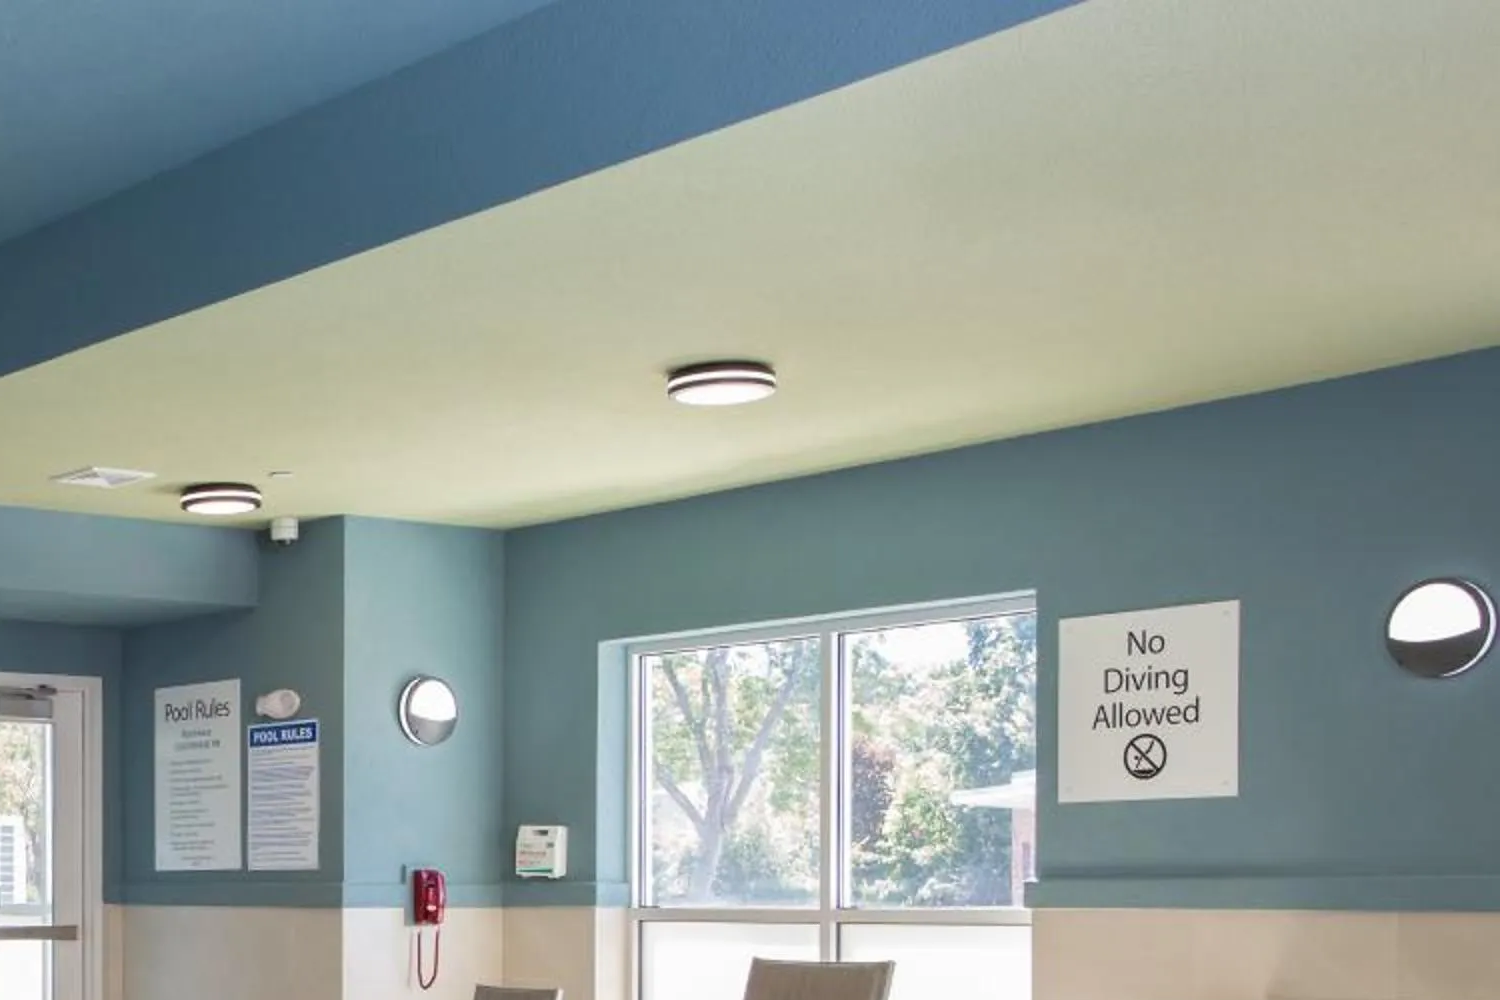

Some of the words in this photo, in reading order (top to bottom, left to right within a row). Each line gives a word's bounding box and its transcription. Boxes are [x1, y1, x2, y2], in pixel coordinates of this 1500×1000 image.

[1127, 630, 1165, 656] No
[1104, 665, 1189, 695] Diving
[165, 702, 193, 721] Pool
[195, 697, 231, 720] Rules
[1092, 695, 1200, 730] Allowed
[253, 729, 279, 744] POOL
[281, 726, 313, 740] RULES
